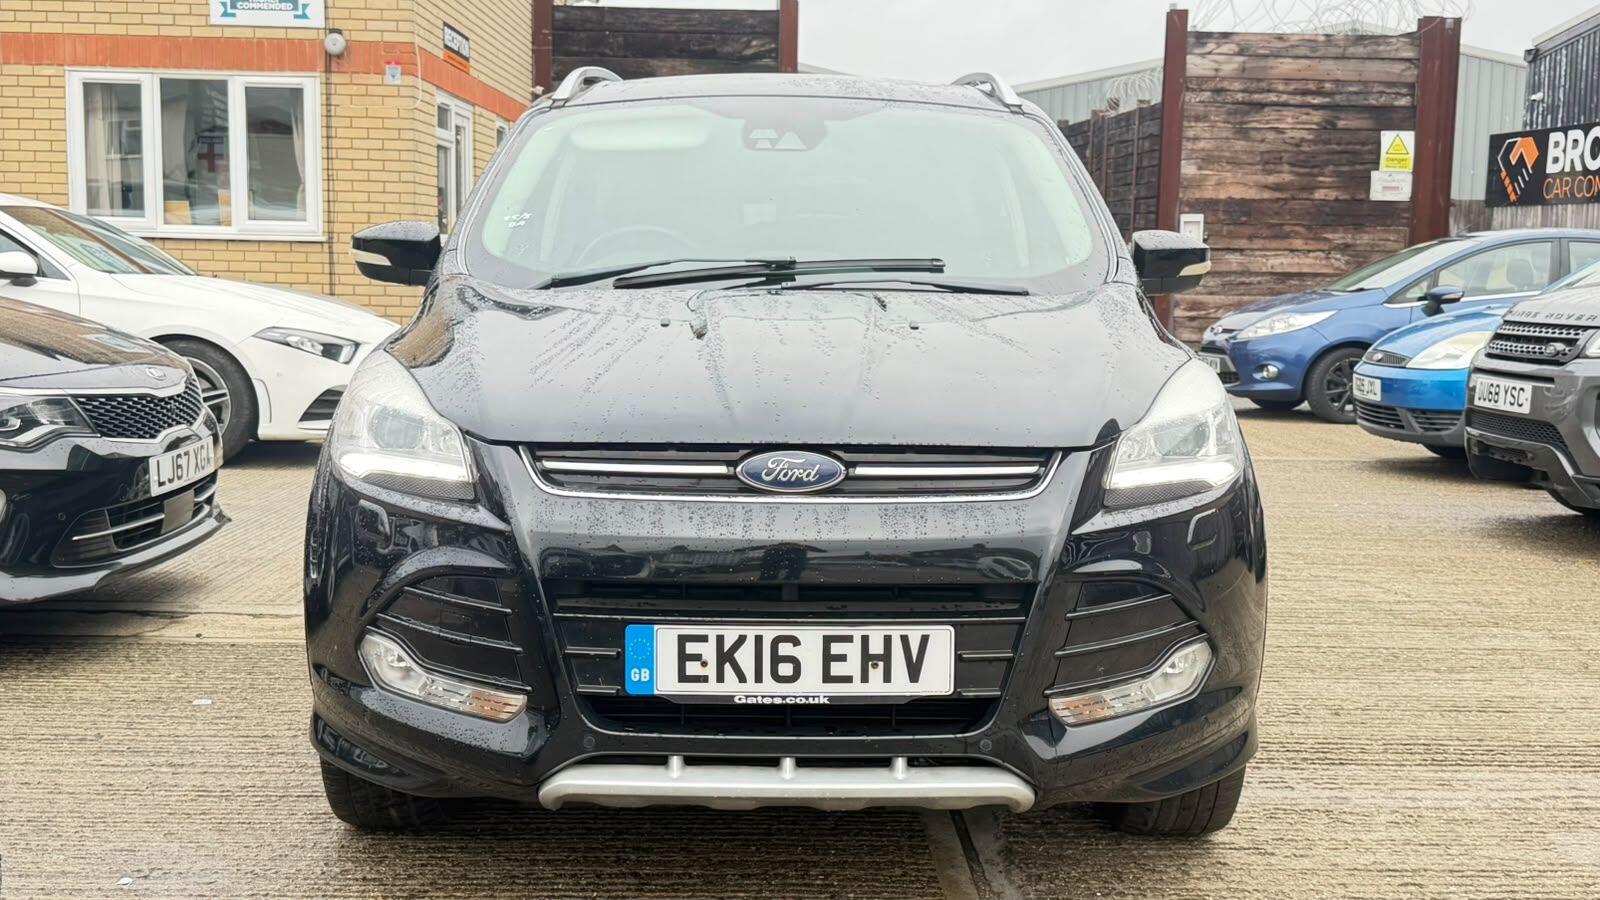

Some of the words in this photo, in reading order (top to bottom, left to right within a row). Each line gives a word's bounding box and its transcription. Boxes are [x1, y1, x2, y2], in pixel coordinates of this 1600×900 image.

[236, 2, 293, 10] COMMENDED
[1543, 177, 1571, 199] CAR
[1503, 385, 1525, 408] YSC
[157, 450, 190, 487] LJ67
[193, 442, 211, 474] XGA
[761, 457, 820, 482] Ford
[676, 634, 802, 684] EK16
[821, 634, 930, 684] EHV
[631, 668, 650, 681] GB
[733, 695, 830, 704] Gates.co.uk
